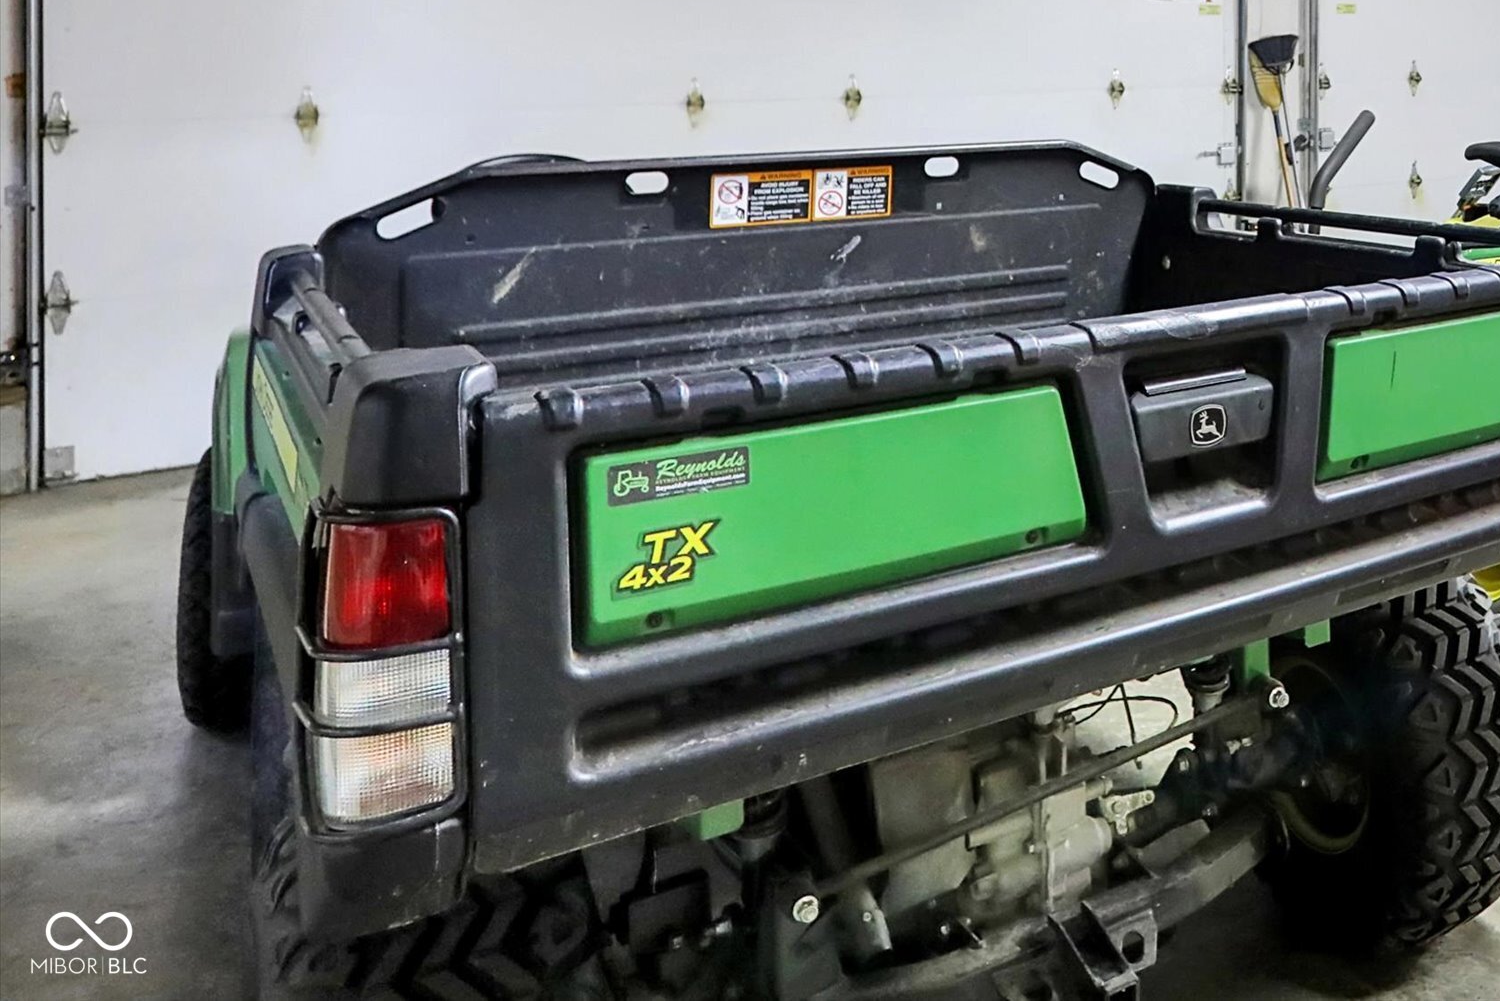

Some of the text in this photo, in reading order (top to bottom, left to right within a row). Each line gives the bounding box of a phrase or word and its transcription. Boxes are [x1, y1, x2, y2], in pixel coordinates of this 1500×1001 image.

[767, 172, 802, 180] WARNING
[655, 451, 746, 480] Reynolds
[643, 519, 716, 565] TX
[618, 555, 694, 590] 4x2
